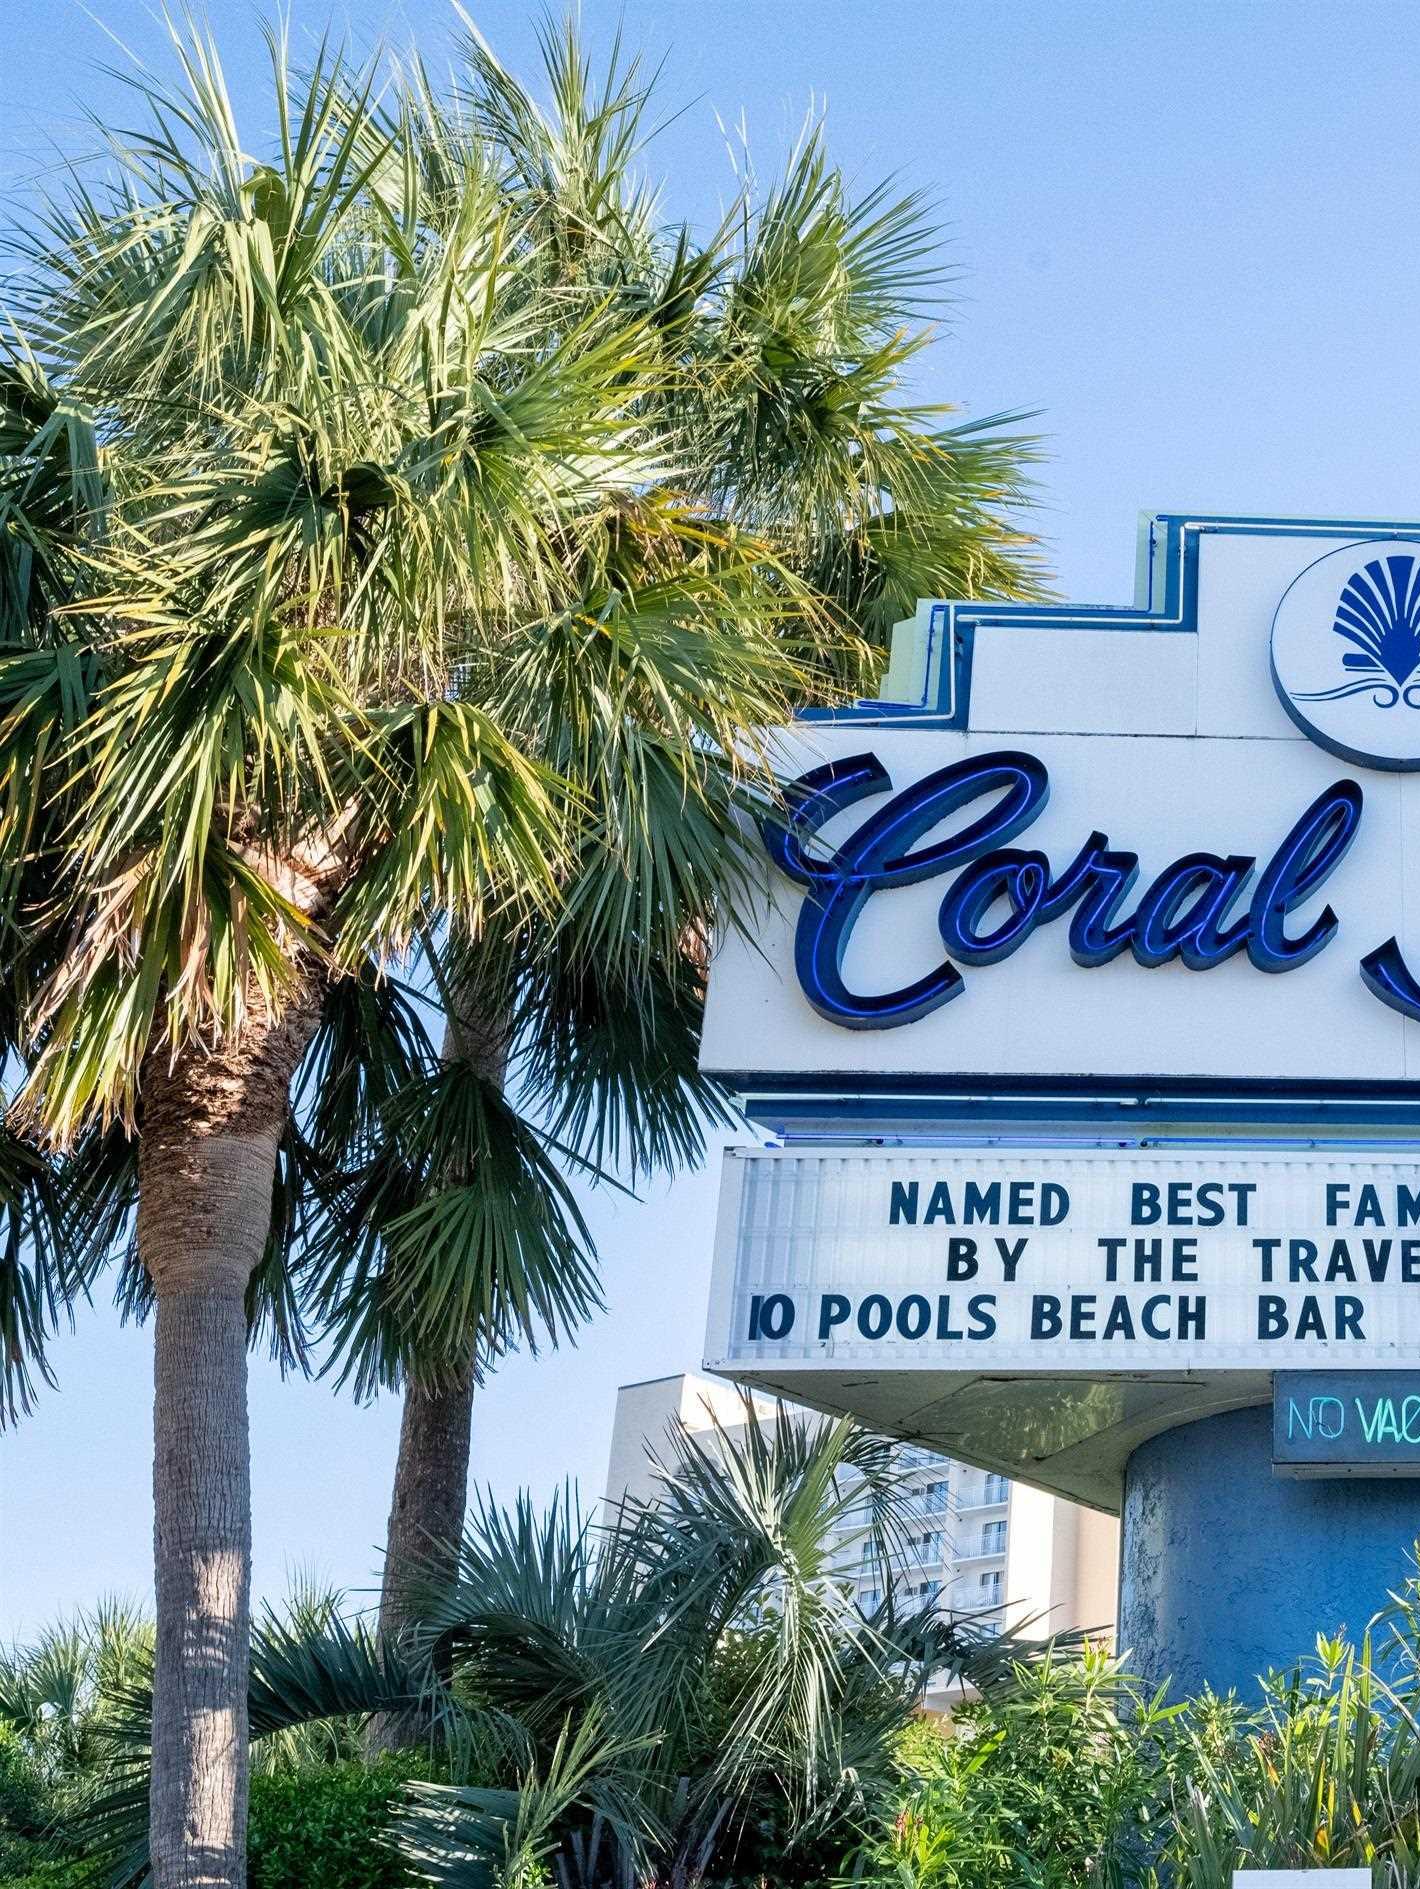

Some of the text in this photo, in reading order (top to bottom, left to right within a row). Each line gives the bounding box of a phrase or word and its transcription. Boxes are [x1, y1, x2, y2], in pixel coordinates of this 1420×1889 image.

[757, 750, 1366, 1031] Coral
[888, 1180, 1071, 1227] NAMED
[1130, 1181, 1258, 1228] BEST
[946, 1237, 1030, 1283] BY
[1097, 1237, 1199, 1283] THE
[747, 1293, 1367, 1341] 10 POOLS BEACH BAR
[1287, 1396, 1346, 1441] NO
